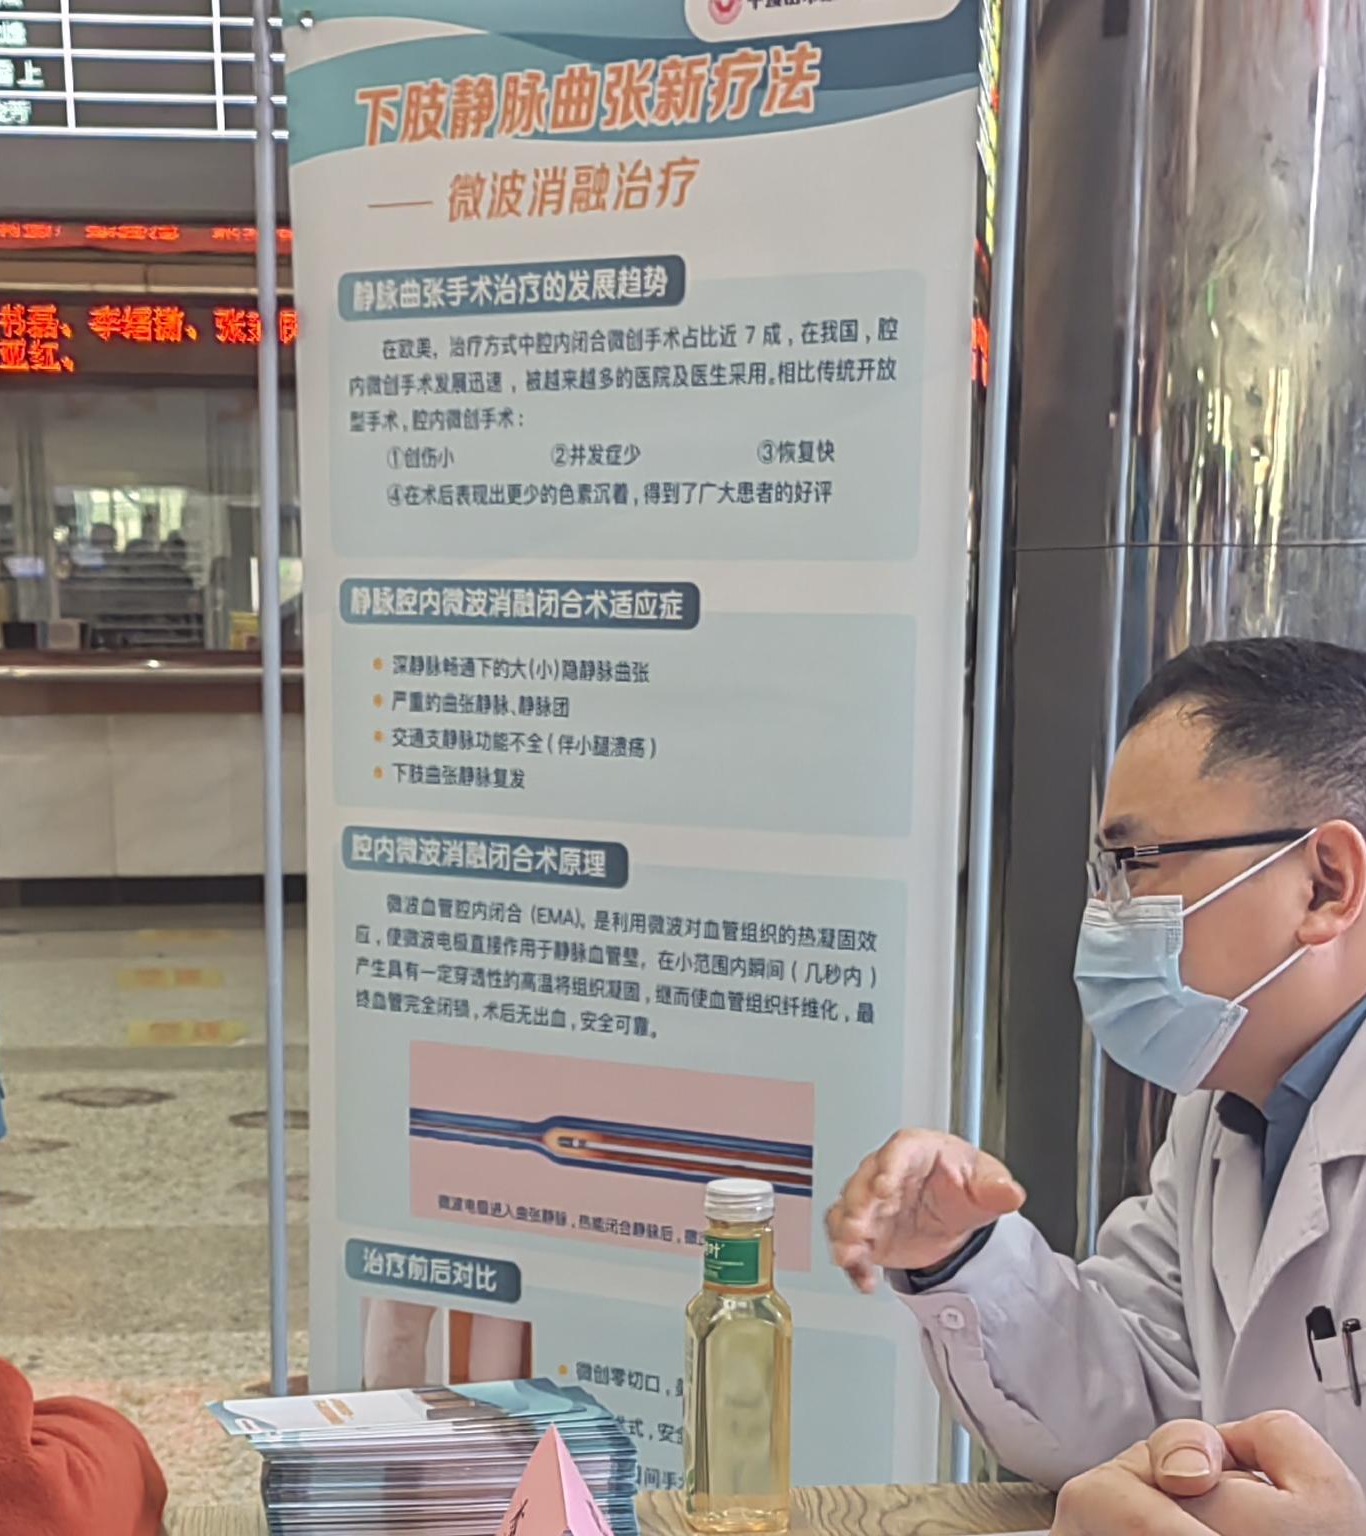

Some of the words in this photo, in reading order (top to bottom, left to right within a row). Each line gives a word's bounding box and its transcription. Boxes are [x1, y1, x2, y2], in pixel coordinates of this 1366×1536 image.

[354, 42, 823, 148] 下肢静脉曲张新疗法
[353, 264, 670, 313] 静脉曲张手术治疗的发展趋势
[350, 585, 685, 624] 静脉腔内微波消融闭合术适应症
[350, 832, 607, 880] 腔内微波消融闭合术原理
[363, 1246, 498, 1293] 治疗前后对比
